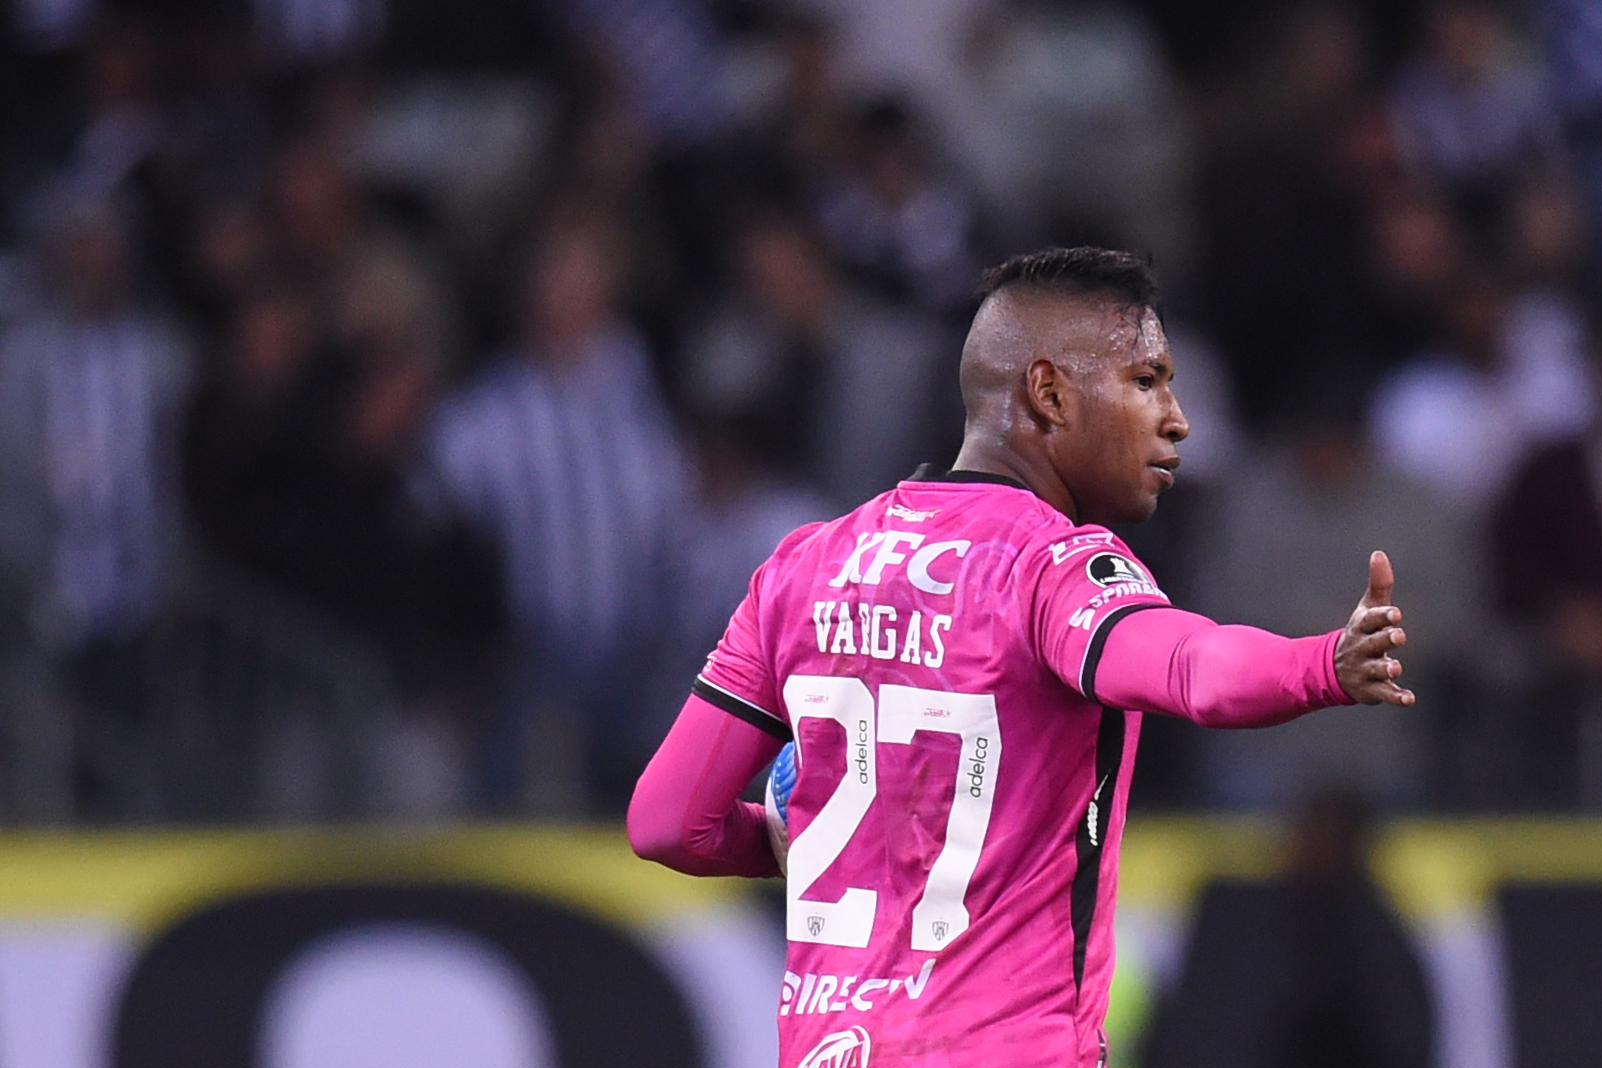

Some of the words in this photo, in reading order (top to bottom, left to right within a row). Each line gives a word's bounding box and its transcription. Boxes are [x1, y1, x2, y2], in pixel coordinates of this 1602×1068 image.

[828, 530, 971, 595] KFC
[855, 720, 868, 785] adelca
[967, 737, 989, 798] adelca
[783, 674, 1002, 952] 27
